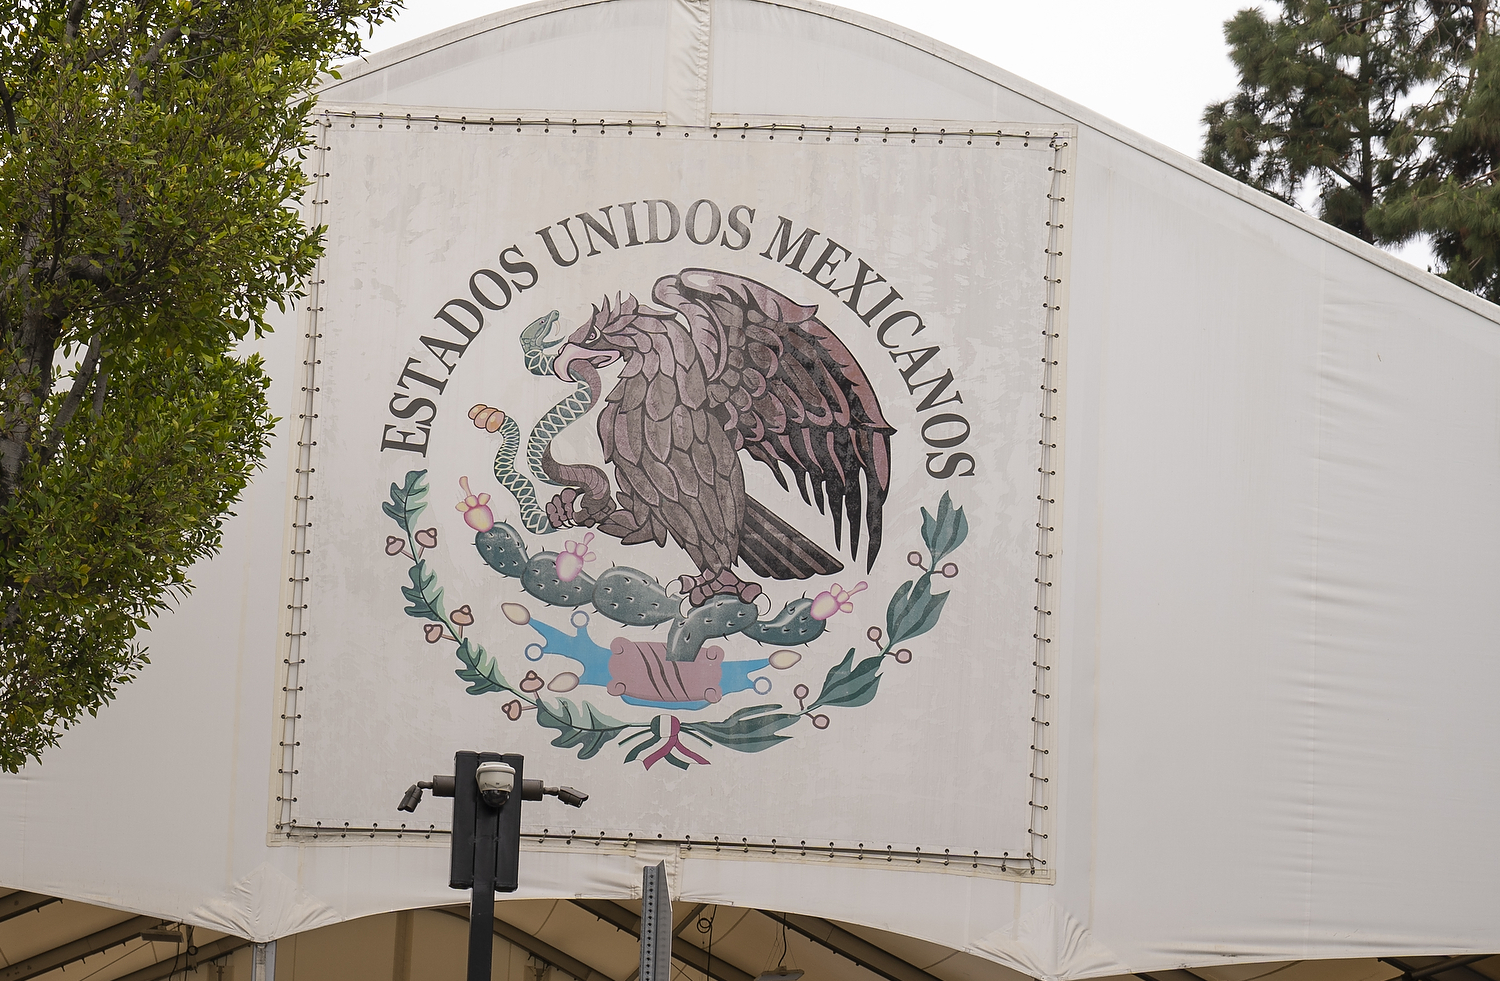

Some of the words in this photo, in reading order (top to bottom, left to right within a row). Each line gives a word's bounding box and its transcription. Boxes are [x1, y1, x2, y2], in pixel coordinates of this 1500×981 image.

[380, 243, 540, 459] ESTADOS
[534, 197, 756, 268] UNIDOS
[758, 214, 977, 484] MEXICANOS
